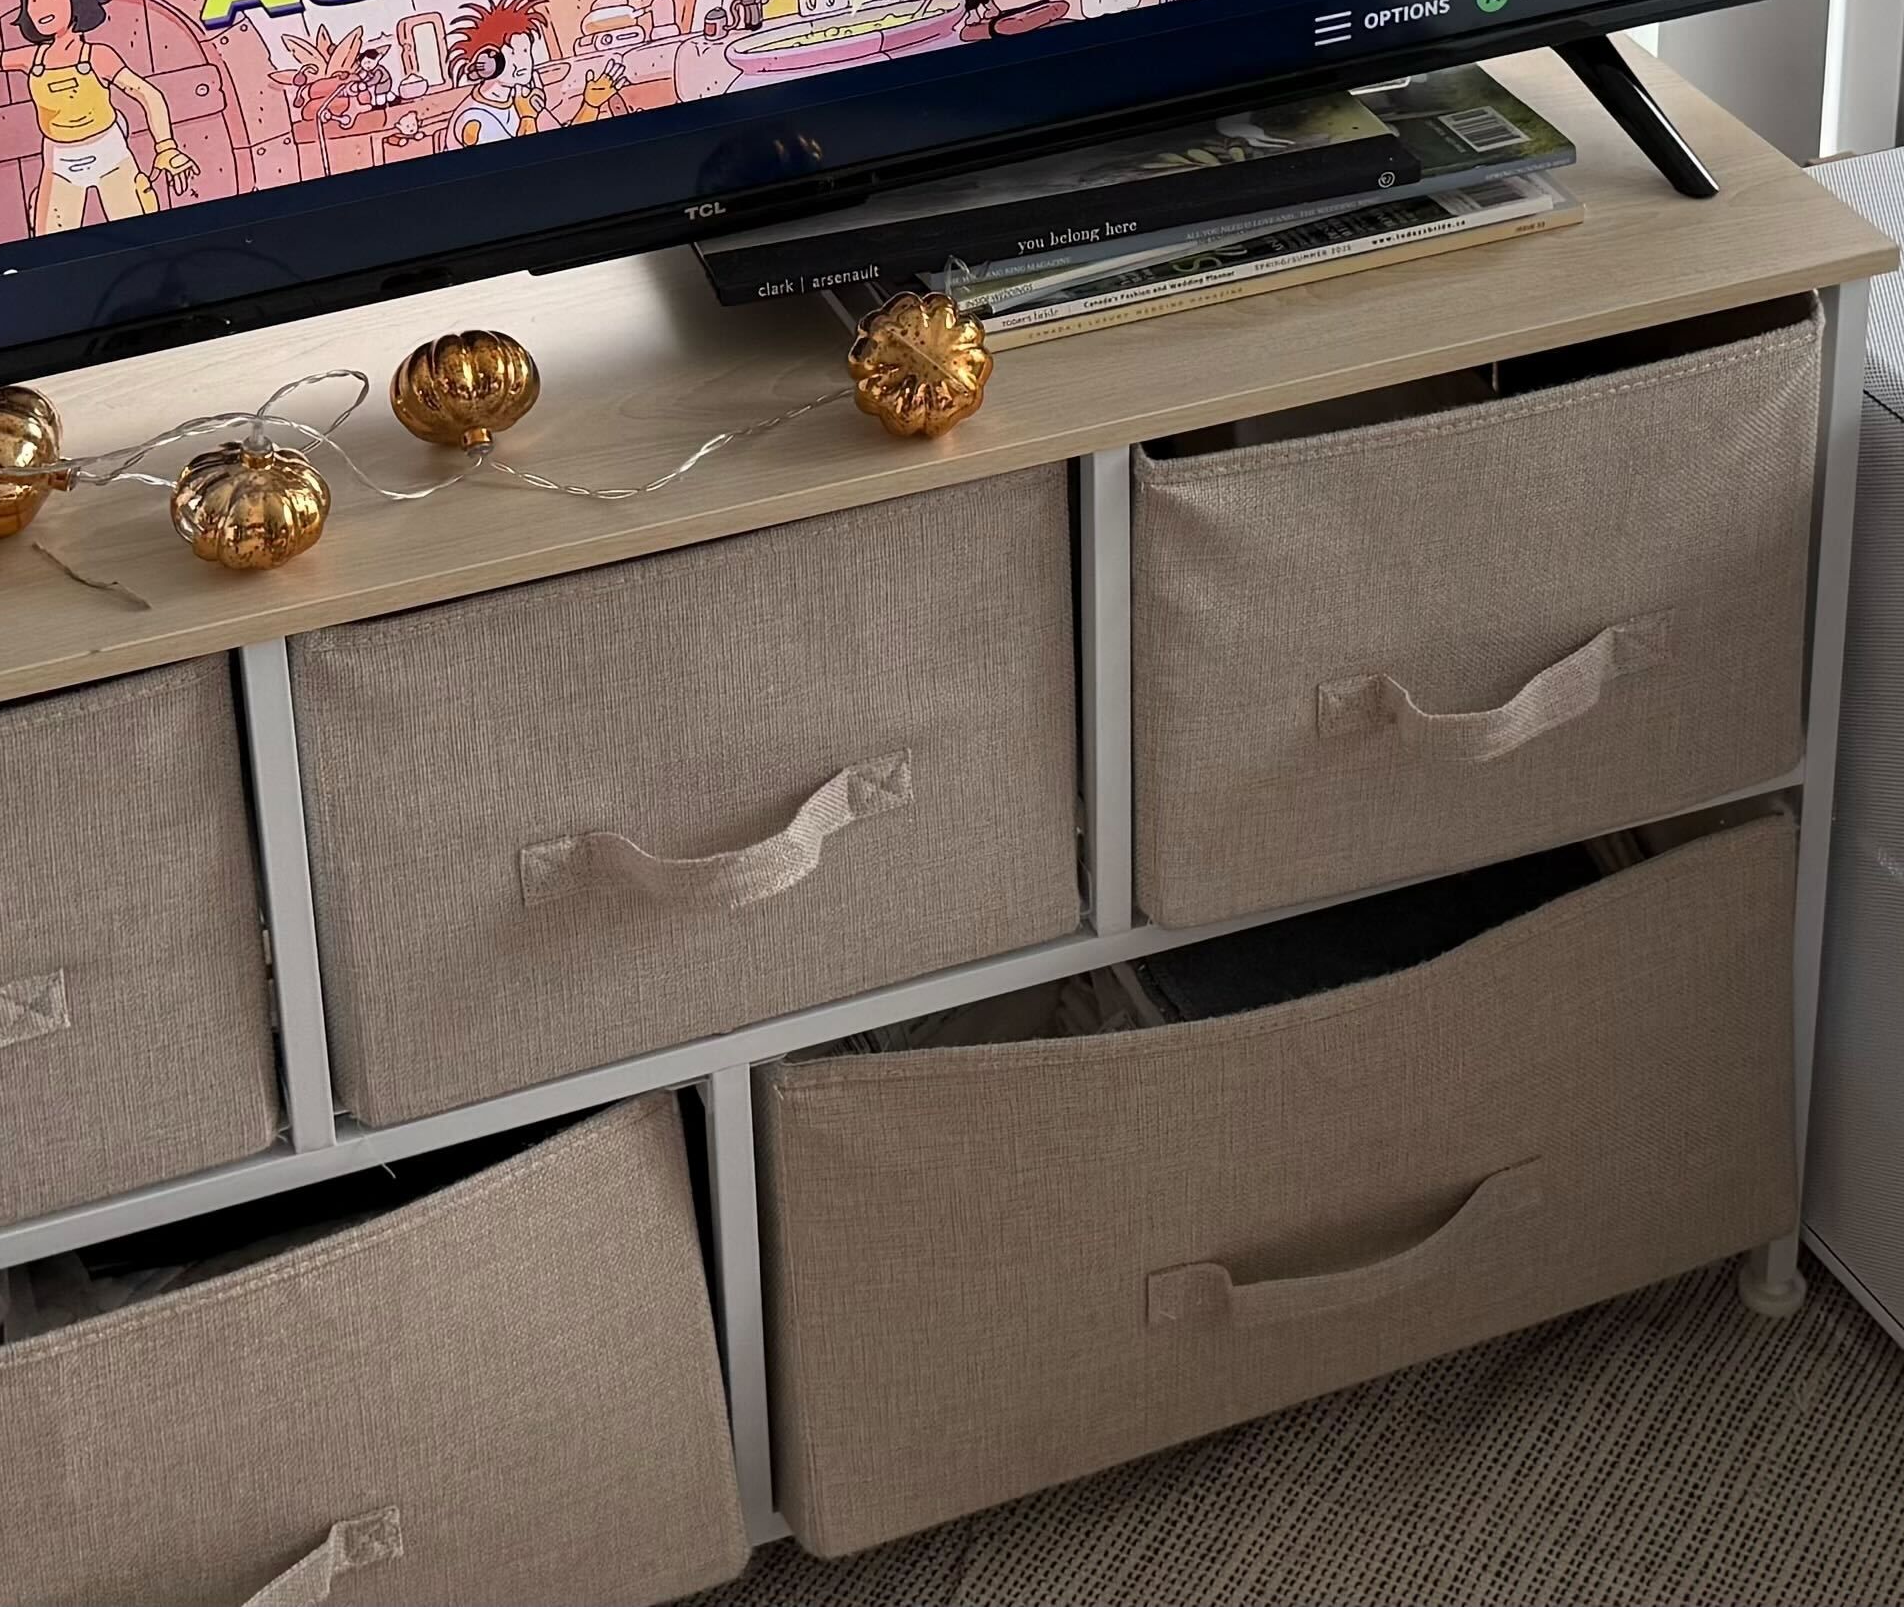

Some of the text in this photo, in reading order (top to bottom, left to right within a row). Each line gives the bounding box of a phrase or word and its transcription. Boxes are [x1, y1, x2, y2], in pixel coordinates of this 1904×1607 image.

[684, 201, 727, 221] TCL
[1018, 221, 1137, 254] you belong here
[1254, 249, 1328, 271] SPRING/SUMMER
[758, 264, 880, 297] clark arsenault
[1083, 270, 1235, 309] Canada's Fashion and Wedding Planner
